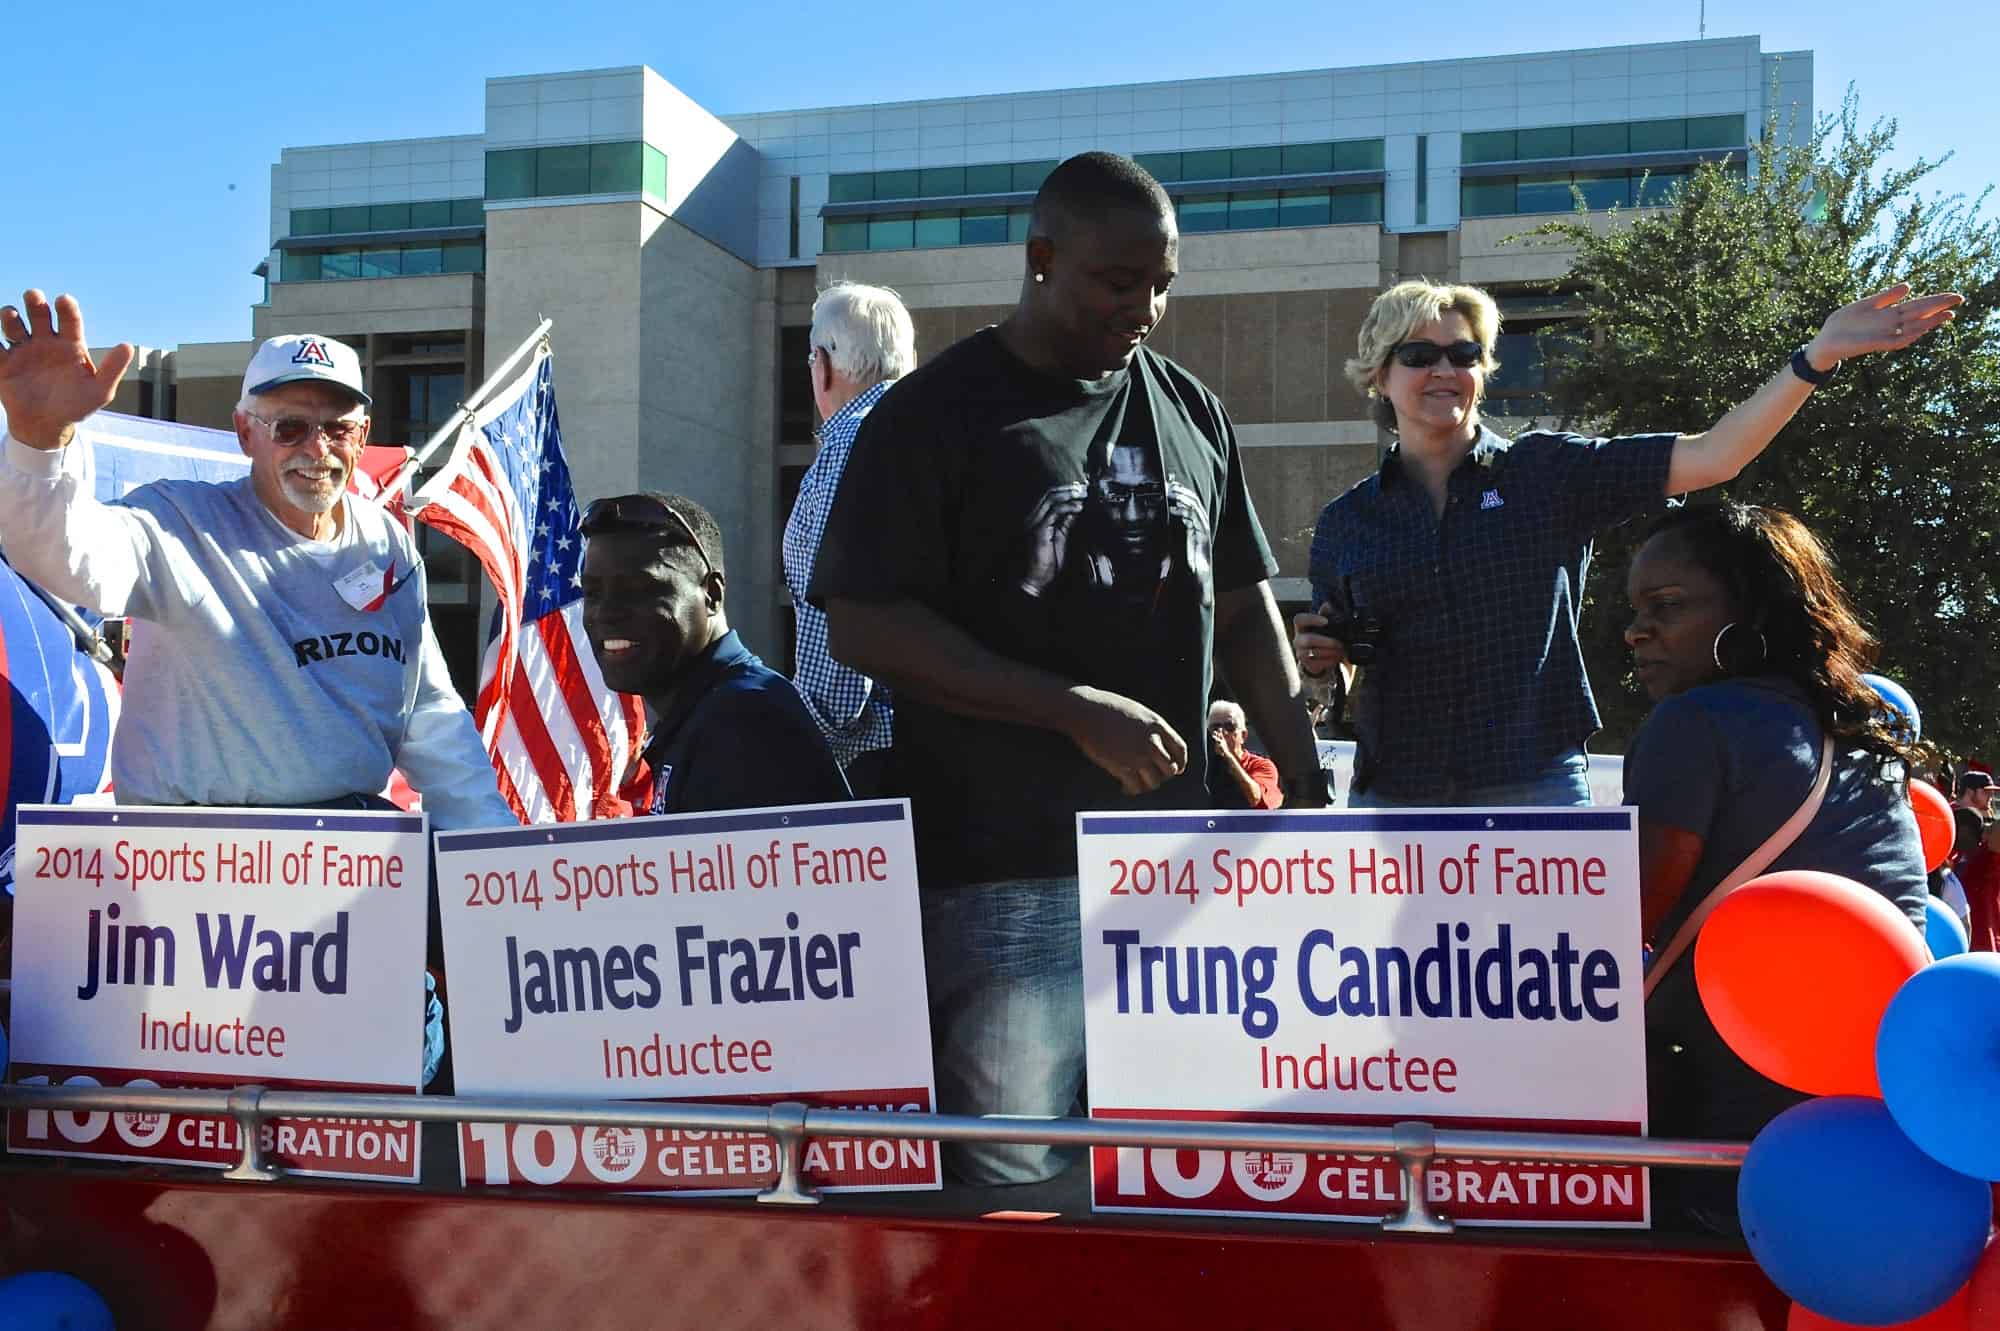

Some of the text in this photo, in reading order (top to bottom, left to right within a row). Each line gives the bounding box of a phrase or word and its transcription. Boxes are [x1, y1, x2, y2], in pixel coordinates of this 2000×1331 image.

[291, 340, 334, 368] A
[294, 631, 406, 668] RIZON
[35, 841, 403, 891] 2014 Sports Hall of Fame
[465, 841, 887, 911] 2014 Sports Hall of Fame
[1110, 844, 1606, 907] 2014 Sports Hall of Fame
[77, 903, 349, 1000] Jim Ward
[505, 912, 860, 1033] James Frazier
[1103, 922, 1620, 1039] Trung Candidate
[141, 1012, 286, 1057] Inductee
[604, 1034, 772, 1078] Inductee
[1261, 1044, 1457, 1093] Inductee
[657, 1139, 926, 1177] CELEBATION
[1318, 1167, 1633, 1206] CELBRATION
